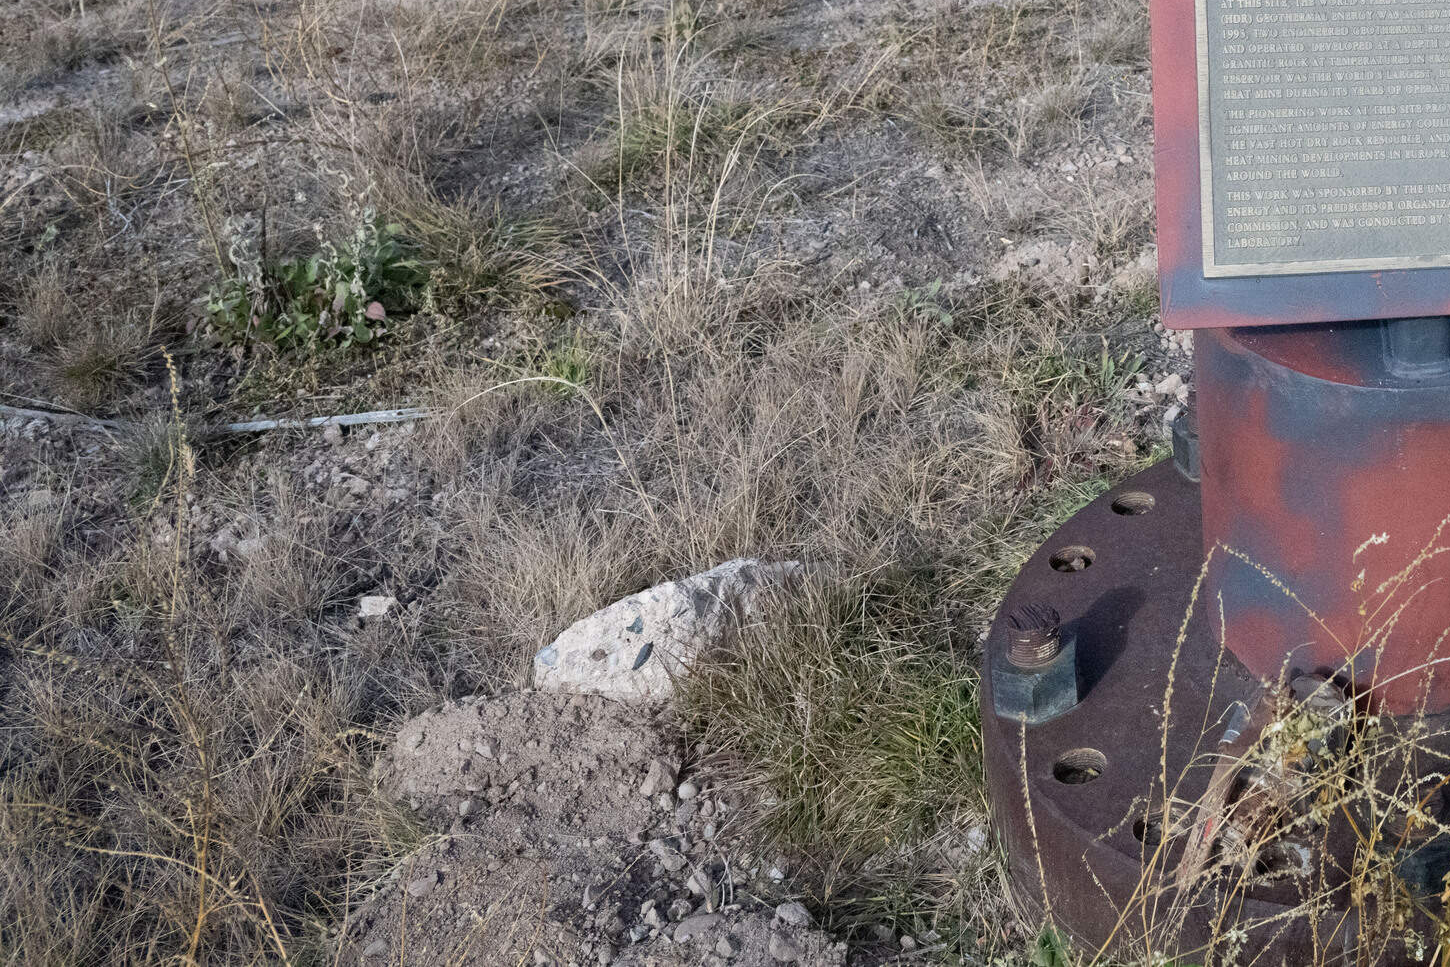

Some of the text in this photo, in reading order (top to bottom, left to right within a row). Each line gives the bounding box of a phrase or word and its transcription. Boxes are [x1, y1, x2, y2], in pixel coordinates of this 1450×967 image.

[1220, 13, 1252, 27] (HDR)
[1255, 11, 1327, 24] GEOTHERMAL
[1331, 9, 1373, 22] ENERGY
[1352, 23, 1423, 36] GEOTHERMAL
[1222, 44, 1244, 56] AND
[1311, 40, 1372, 53] DEVELOPED
[1376, 39, 1388, 51] AT
[1222, 58, 1274, 71] GRANITIC
[1278, 57, 1308, 69] ROCK
[1312, 56, 1325, 68] AT
[1330, 54, 1410, 67] TEMPERATURES
[1414, 53, 1425, 65] IN
[1223, 73, 1281, 86] RESERVOIR
[1285, 72, 1307, 84] WAS
[1312, 71, 1332, 83] THE
[1223, 89, 1251, 101] HEAT
[1255, 88, 1281, 100] MINE
[1286, 86, 1328, 99] DURING
[1331, 86, 1347, 97] ITS
[1248, 106, 1314, 120] PIONEERING
[1319, 105, 1351, 117] WORK
[1355, 104, 1367, 116] AT
[1373, 103, 1396, 115] THIS
[1399, 102, 1421, 114] SITE
[1224, 122, 1293, 136] IGNIFICANT
[1296, 120, 1350, 134] AMOUNTS
[1353, 119, 1367, 132] OF
[1371, 118, 1412, 131] ENERGY
[1225, 139, 1246, 152] HE
[1249, 138, 1276, 151] VAST
[1279, 137, 1302, 150] HOT
[1306, 136, 1328, 149] DRY
[1332, 135, 1363, 148] ROCK
[1429, 132, 1450, 144] AND
[1225, 155, 1253, 167] HEAT
[1257, 153, 1298, 166] MINING
[1302, 150, 1386, 164] DEVELOPMENTS
[1389, 149, 1401, 161] IN
[1226, 169, 1273, 182] AROUND
[1276, 168, 1297, 180] THE
[1226, 190, 1250, 202] THIS
[1254, 188, 1288, 201] WORK
[1292, 187, 1315, 200] WAS
[1318, 184, 1381, 199] SPONSORED
[1385, 184, 1400, 196] BY
[1403, 183, 1423, 195] THE
[1226, 204, 1271, 218] ENERGY
[1274, 203, 1297, 216] AND
[1301, 202, 1316, 215] ITS
[1320, 199, 1394, 215] PREDECESSOR
[1305, 217, 1327, 231] AND
[1332, 216, 1354, 230] WAS
[1358, 213, 1426, 229] CONDUCTED
[1430, 212, 1444, 226] BY
